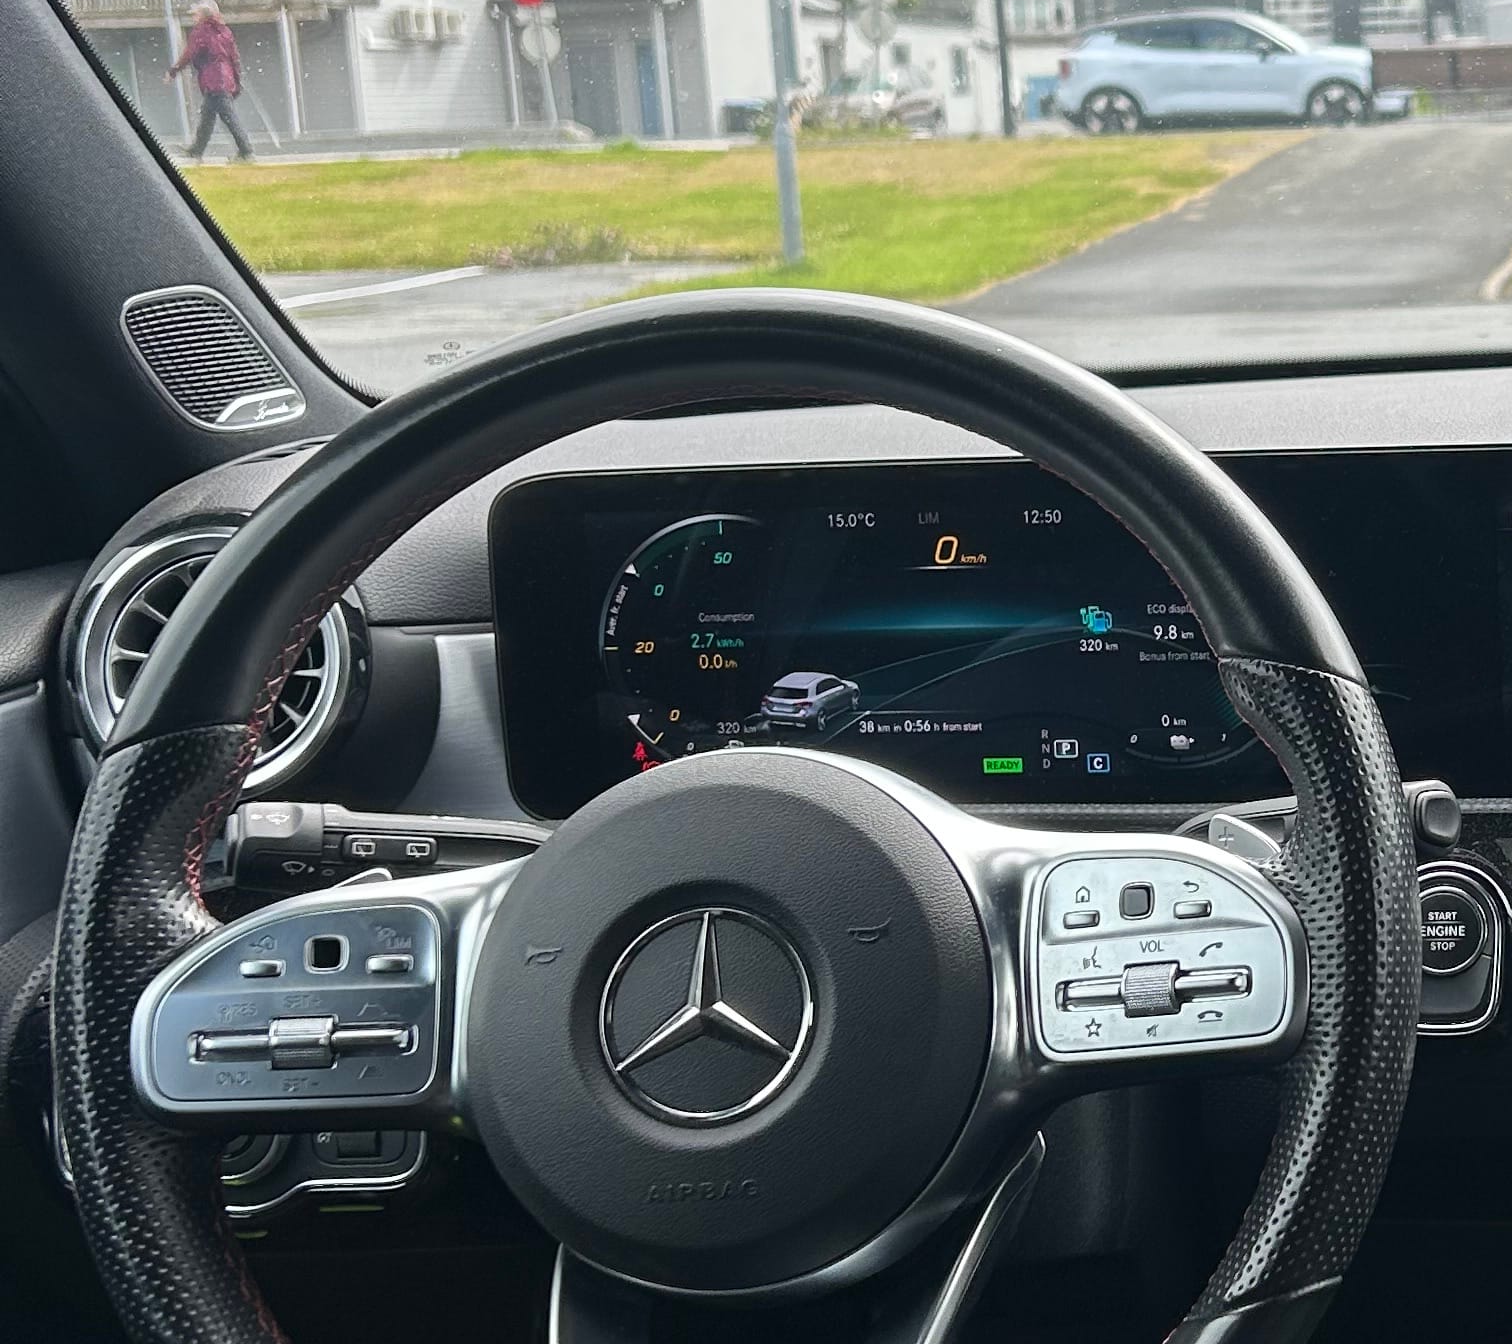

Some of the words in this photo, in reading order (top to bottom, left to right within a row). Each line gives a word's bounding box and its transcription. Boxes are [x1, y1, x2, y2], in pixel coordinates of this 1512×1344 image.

[827, 513, 876, 528] 15.0°C
[918, 512, 940, 524] LIM
[1023, 509, 1062, 524] 12:50
[934, 535, 958, 565] 0
[960, 553, 987, 564] km/h
[713, 552, 732, 564] 50
[653, 584, 665, 596] 0
[1147, 604, 1166, 614] ECO
[1168, 604, 1193, 616] displ
[698, 612, 755, 624] Consumption
[1153, 624, 1178, 640] 9.8
[1181, 630, 1195, 639] km
[690, 633, 714, 649] 2.7
[1079, 639, 1103, 651] 320
[1105, 642, 1119, 651] km
[634, 641, 655, 654] 20
[699, 654, 723, 669] 0.0
[1139, 651, 1166, 661] Bonus
[1168, 651, 1188, 661] from
[1190, 652, 1210, 661] start
[669, 709, 680, 722] 0
[1161, 715, 1170, 726] 0
[1173, 717, 1187, 726] km
[716, 722, 740, 735] 320
[743, 725, 757, 733] km
[859, 720, 875, 733] 38
[878, 722, 891, 732] km
[893, 722, 901, 732] in
[904, 720, 931, 733] 0:56
[934, 722, 940, 731] h
[943, 722, 963, 731] from
[963, 722, 982, 731] start
[1041, 729, 1048, 739] R
[1041, 743, 1050, 754] N
[1061, 743, 1071, 755] P
[985, 759, 1020, 770] READY
[1043, 759, 1051, 769] D
[1093, 758, 1104, 769] C
[1427, 911, 1458, 921] START
[1421, 925, 1466, 937] ENGINE
[1139, 940, 1165, 954] VOL
[1430, 941, 1456, 951] STOP
